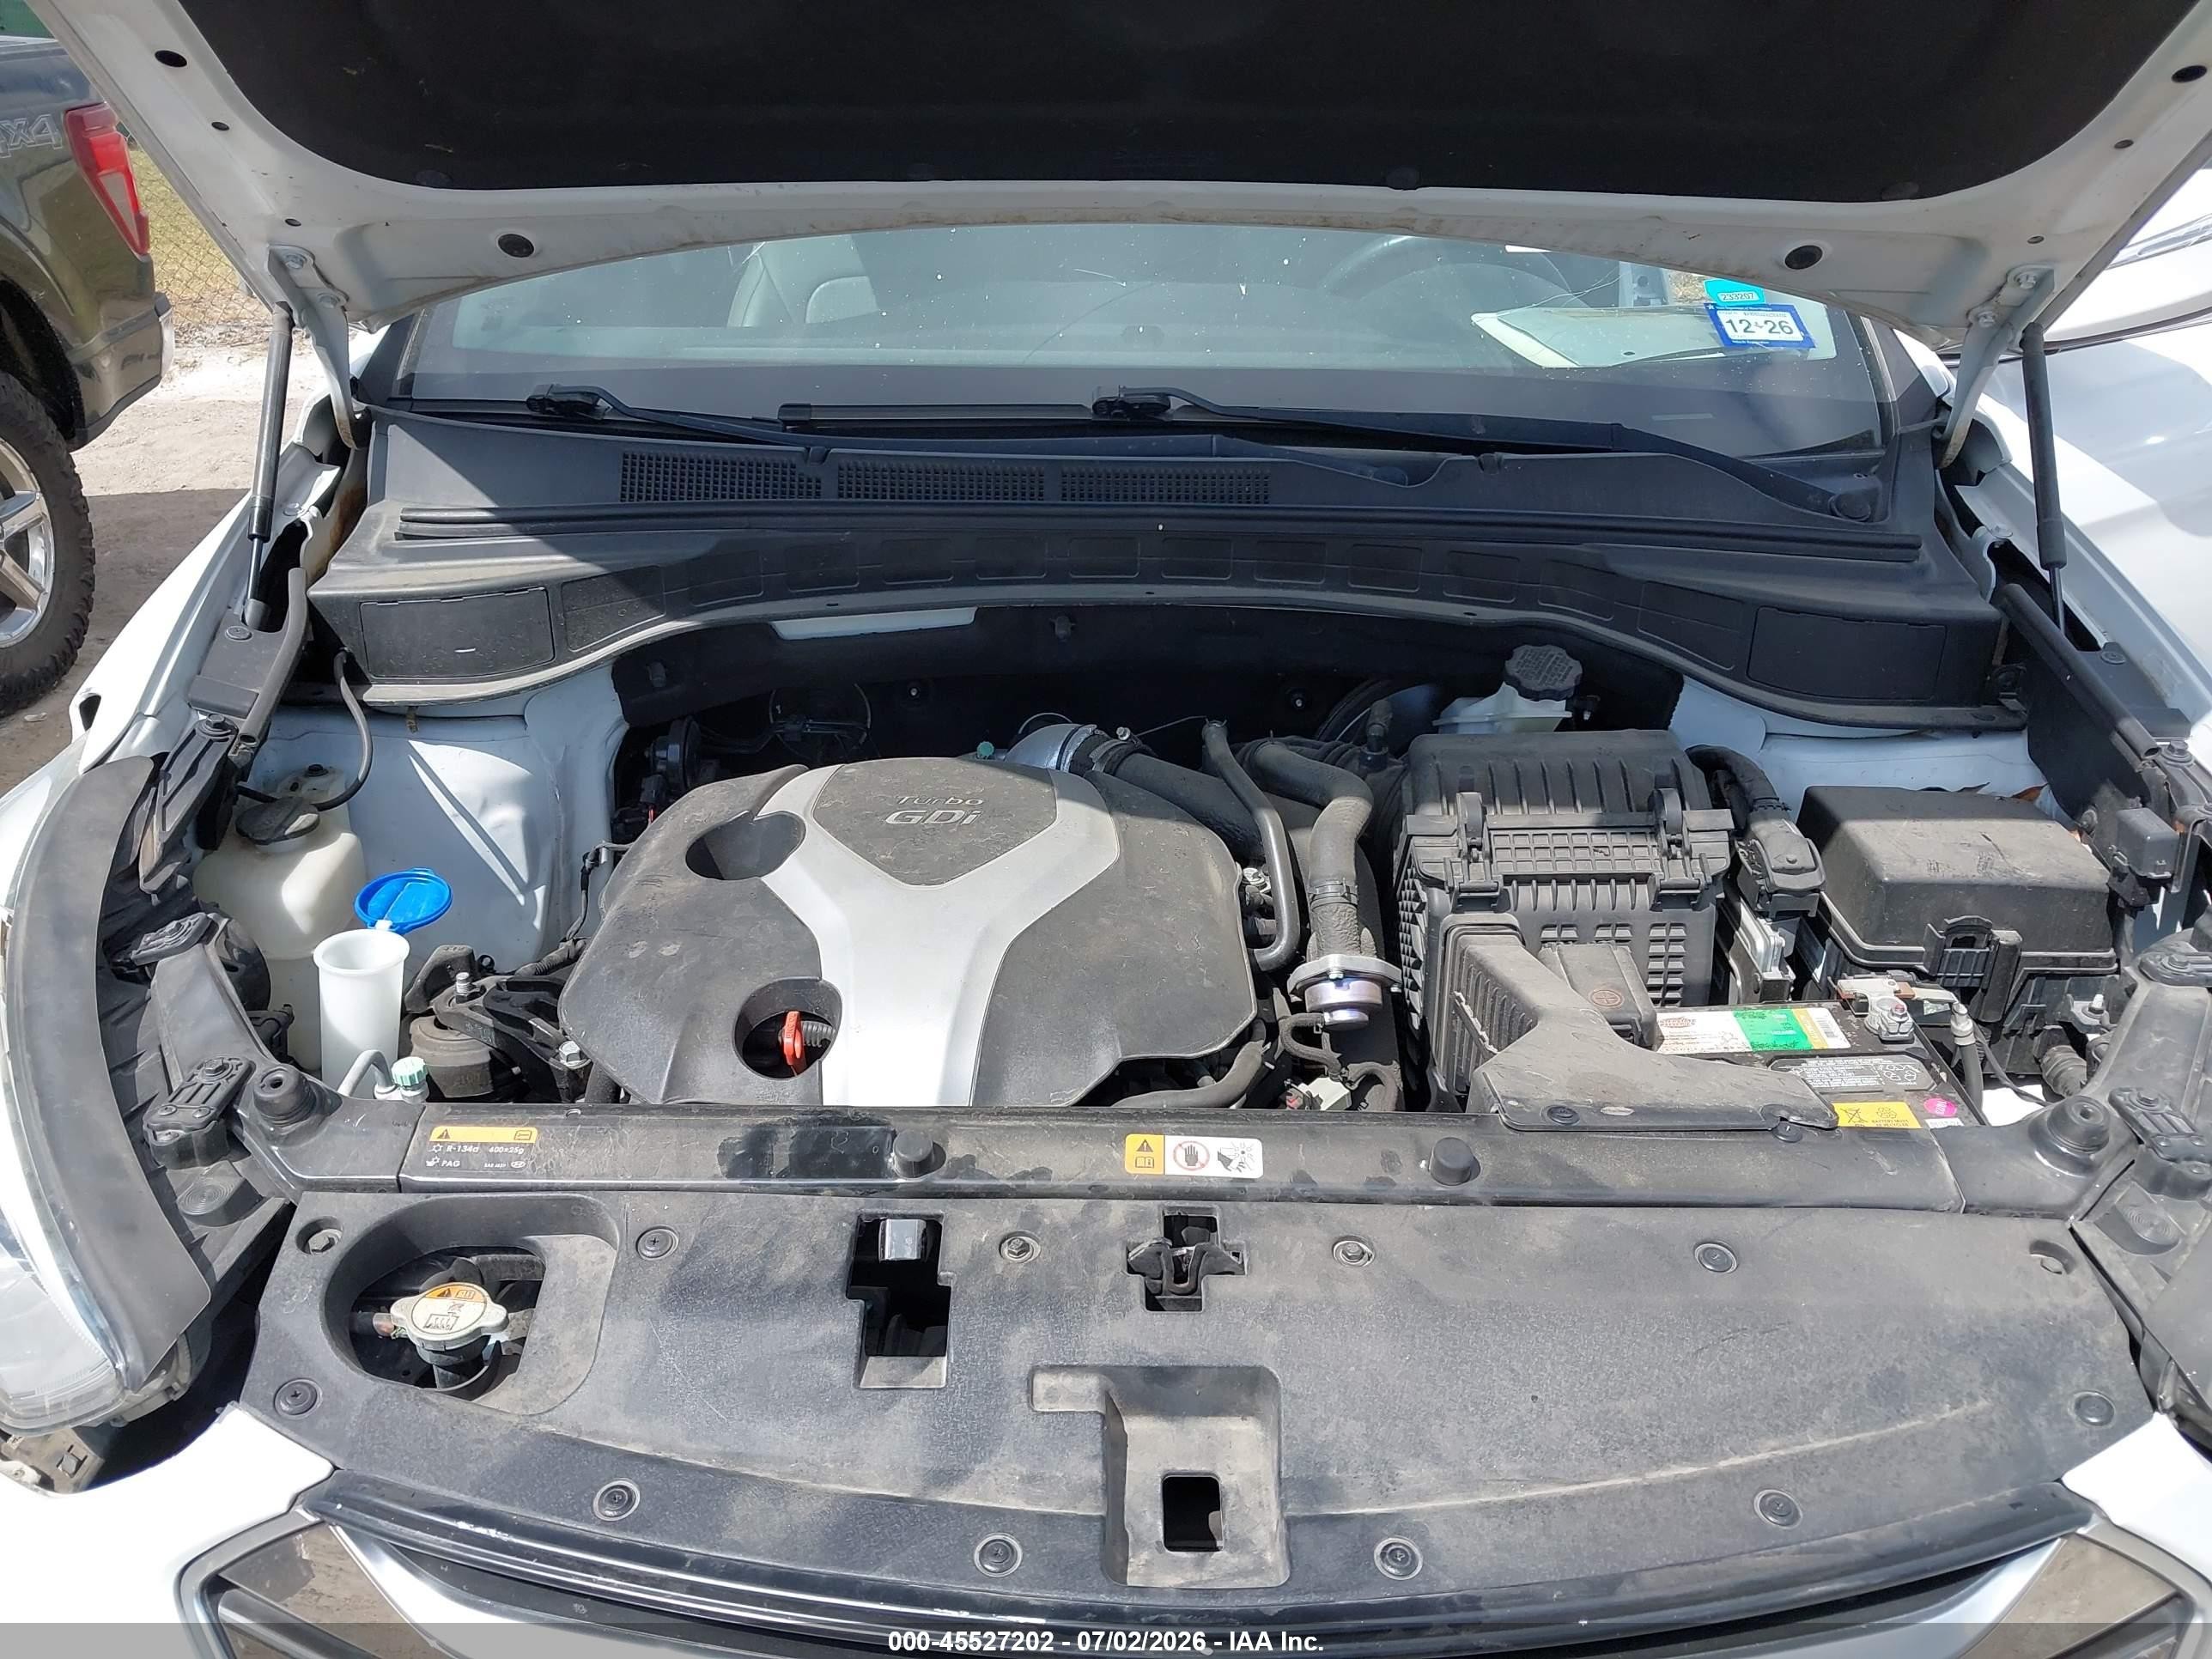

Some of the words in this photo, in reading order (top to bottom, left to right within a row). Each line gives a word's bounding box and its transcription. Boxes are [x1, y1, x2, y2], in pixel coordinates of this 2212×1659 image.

[1720, 292, 1753, 301] 233207
[1725, 319, 1756, 334] 12
[1763, 319, 1794, 335] 26
[896, 795, 984, 805] Turbo
[884, 809, 982, 825] GDi
[446, 1145, 480, 1153] R-134a
